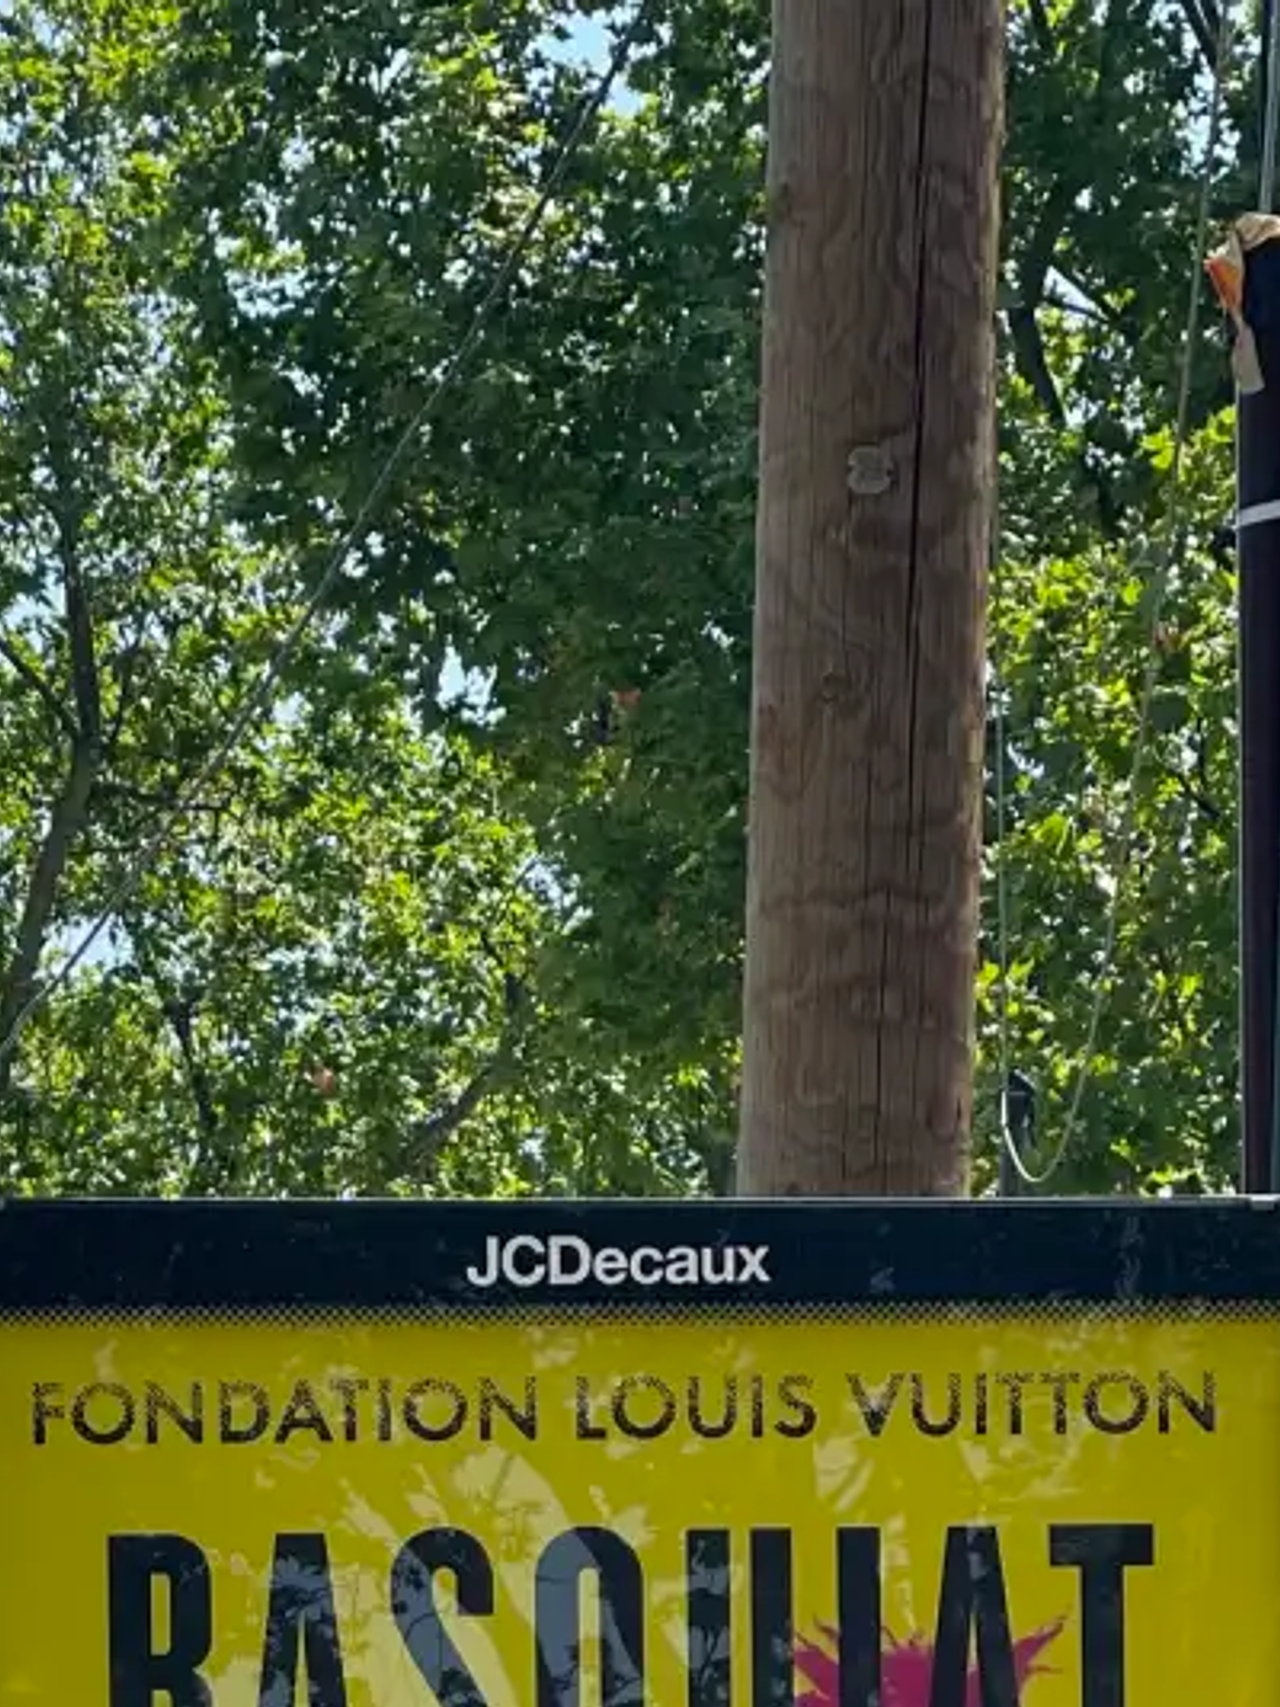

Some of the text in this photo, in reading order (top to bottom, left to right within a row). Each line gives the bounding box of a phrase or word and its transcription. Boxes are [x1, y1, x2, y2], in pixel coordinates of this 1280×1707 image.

[465, 1234, 771, 1289] JCDecaux
[30, 1369, 1218, 1447] FONDATION LOUIS VUITTON
